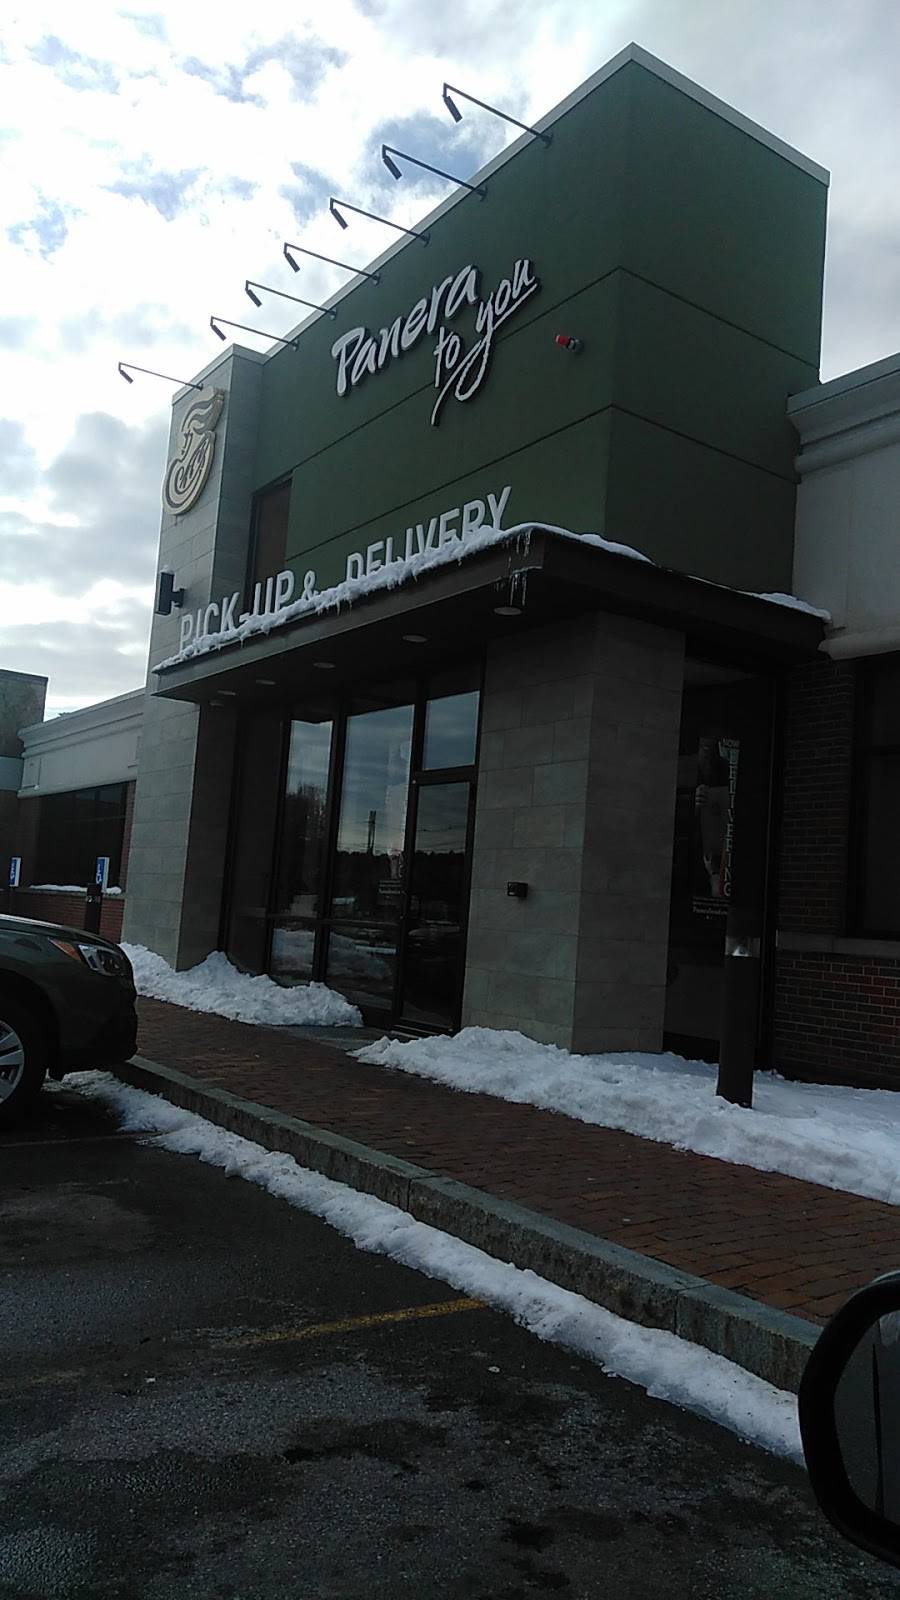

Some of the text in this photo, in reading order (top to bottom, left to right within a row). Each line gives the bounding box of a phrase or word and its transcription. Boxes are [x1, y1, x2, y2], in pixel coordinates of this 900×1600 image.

[331, 264, 477, 397] Panera
[431, 259, 538, 425] to you
[179, 486, 512, 654] PICK-UP & DELIVERY
